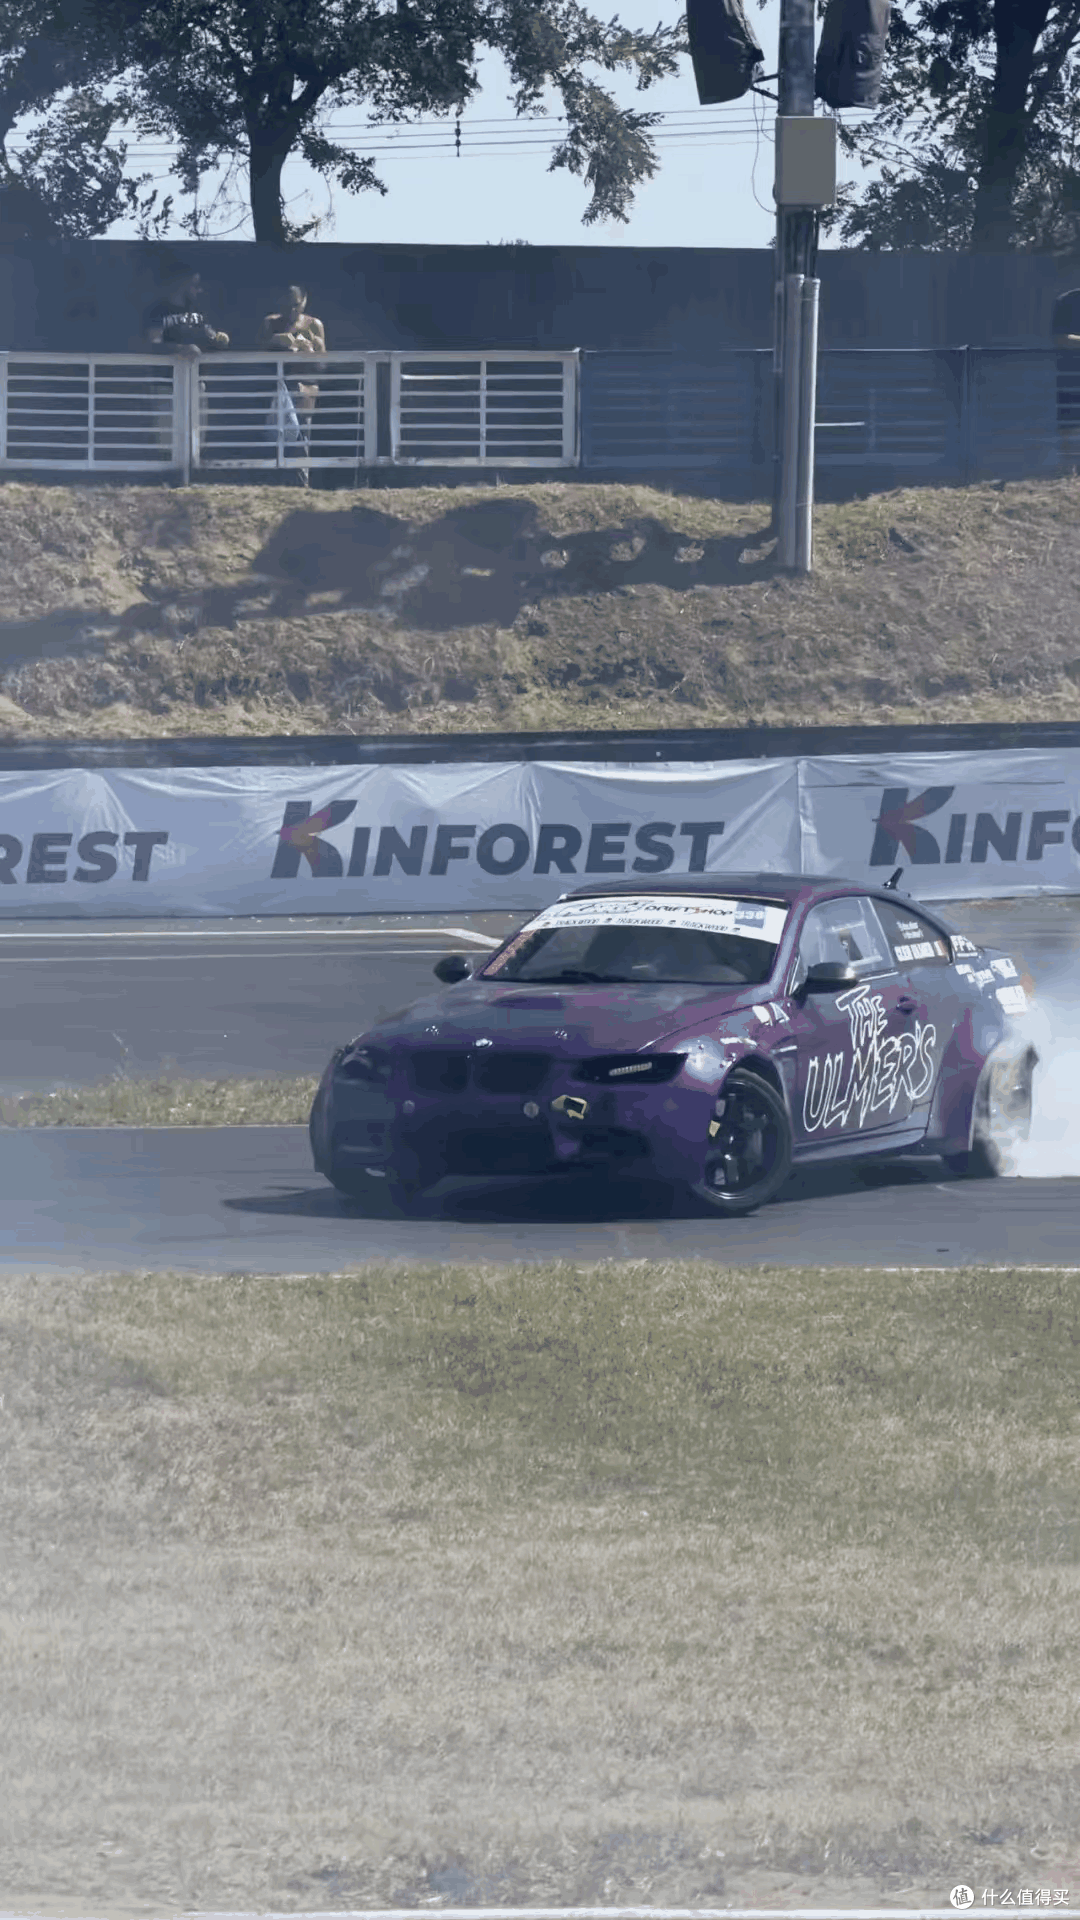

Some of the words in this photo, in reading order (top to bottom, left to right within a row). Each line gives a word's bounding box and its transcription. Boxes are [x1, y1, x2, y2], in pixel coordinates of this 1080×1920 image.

[271, 799, 725, 879] KINFOREST
[869, 785, 1080, 867] KINF
[835, 984, 888, 1051] THE
[803, 1020, 936, 1132] ULMER'S
